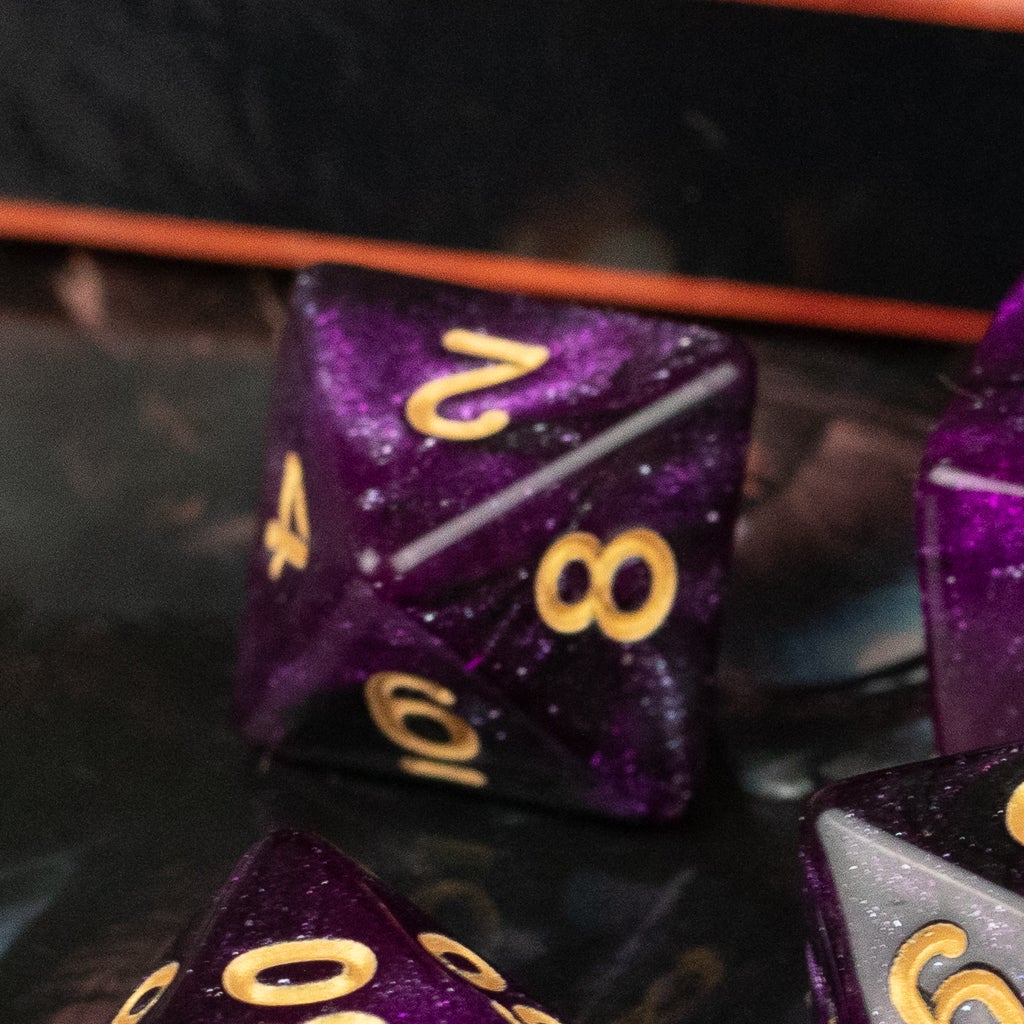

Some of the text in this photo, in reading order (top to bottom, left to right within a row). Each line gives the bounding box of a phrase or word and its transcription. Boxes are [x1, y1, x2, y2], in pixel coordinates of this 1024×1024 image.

[408, 330, 548, 441] 2
[265, 455, 311, 580] 4
[536, 529, 679, 643] 8
